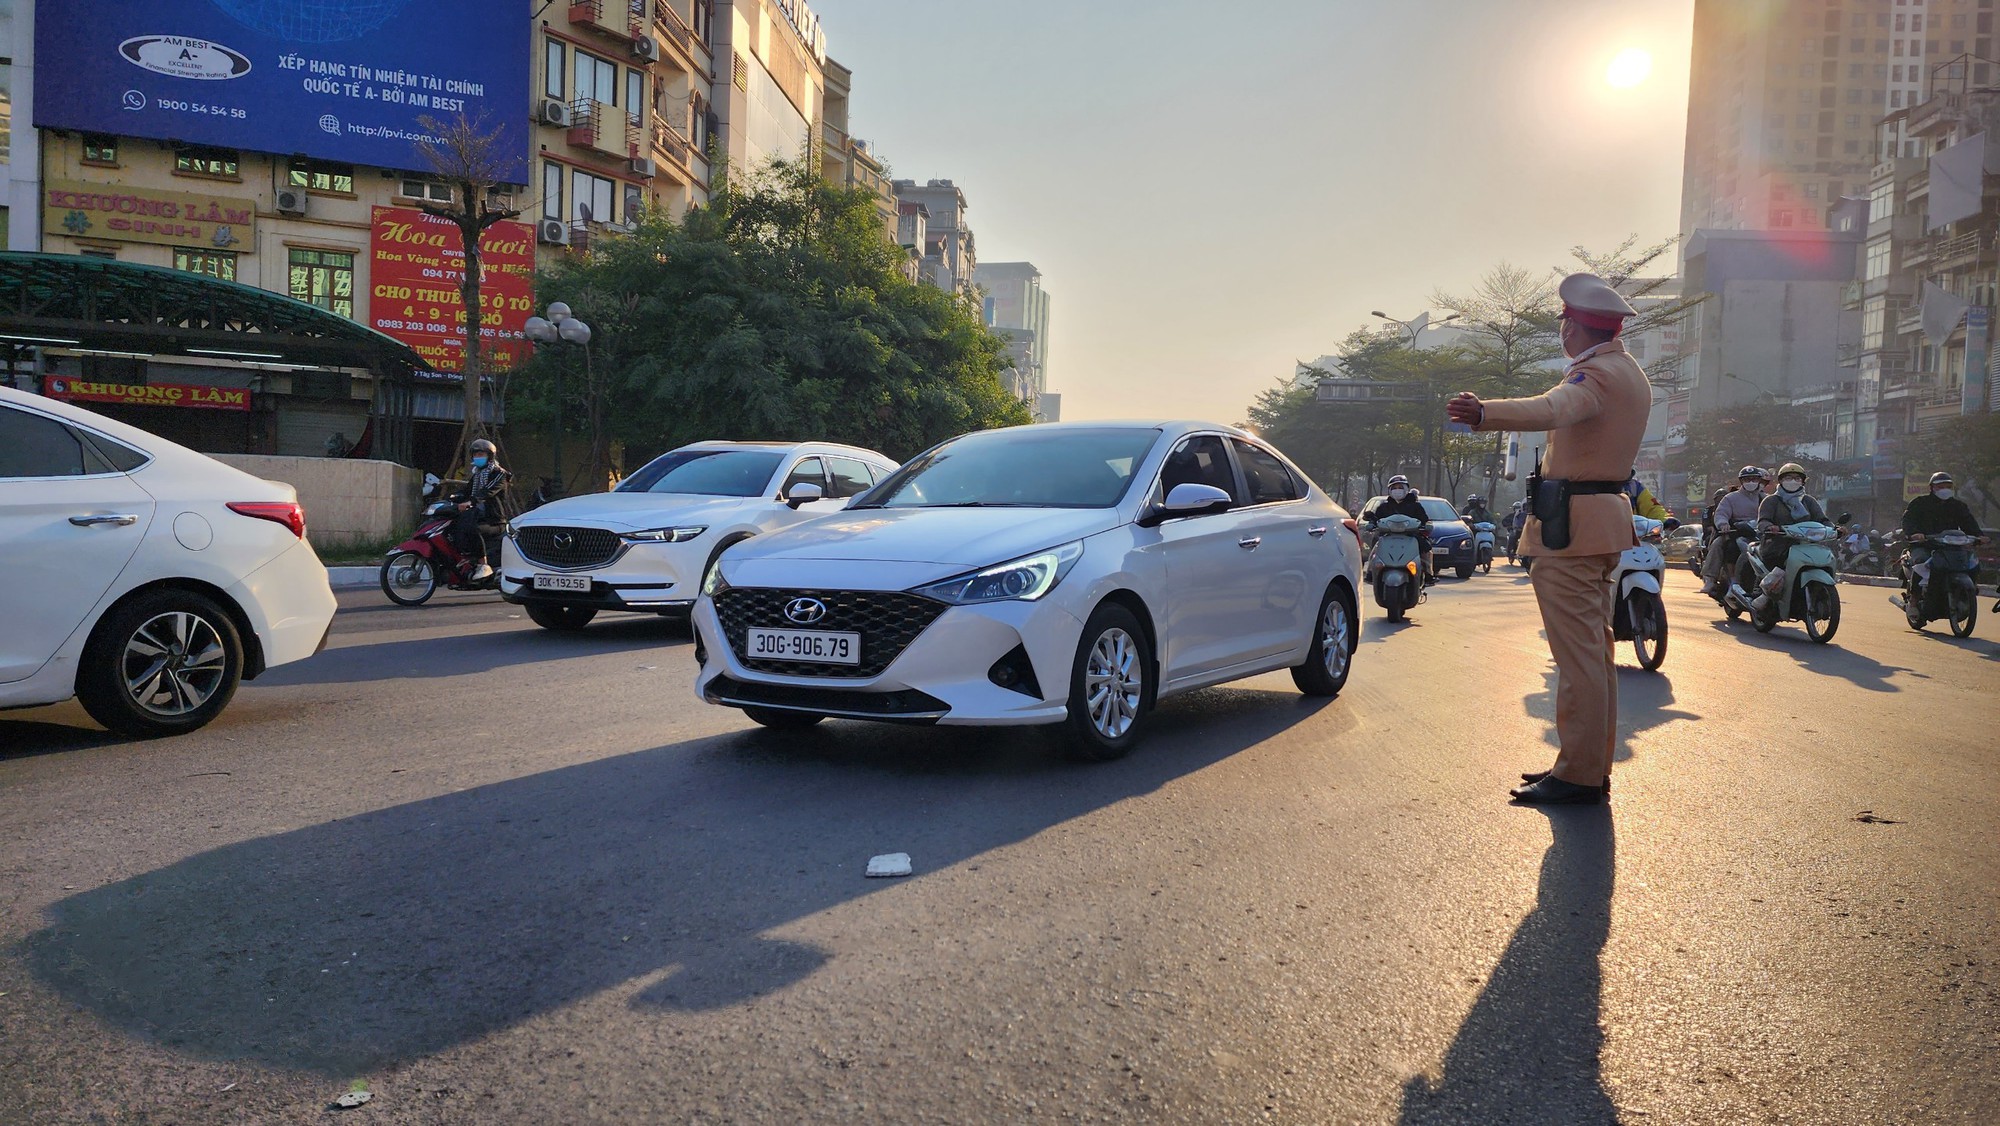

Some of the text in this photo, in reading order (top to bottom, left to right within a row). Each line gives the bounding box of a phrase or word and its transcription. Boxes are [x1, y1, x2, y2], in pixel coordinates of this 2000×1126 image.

[164, 37, 209, 49] AM BEST
[178, 48, 199, 61] A-
[145, 62, 228, 79] Financial Strength Rating
[168, 60, 203, 69] EXCELLENT
[278, 52, 484, 97] XẾP HẠNG TÍN NHIỆM TÀI CHÍNH
[303, 76, 465, 112] QUỐC TẾ A- BỞI AM BEST
[157, 98, 247, 119] 1900 54 54 58
[347, 122, 450, 145] http://pvi.com.vn
[184, 201, 251, 225] LÂM
[107, 218, 200, 238] SINH
[380, 221, 447, 247] Hoa
[376, 250, 402, 262] Hoa
[407, 253, 439, 267] Vòng
[422, 268, 443, 279] 094
[374, 285, 411, 300] CHO
[415, 287, 462, 305] THUÊ
[492, 293, 505, 309] Ô
[509, 296, 531, 311] TÔ
[403, 305, 414, 319] 4
[429, 307, 441, 320] 9
[376, 319, 403, 329] 0983
[406, 320, 424, 331] 203
[426, 322, 447, 333] 008
[479, 327, 496, 337] 765
[416, 343, 449, 356] THUỐC
[190, 387, 244, 404] LÂM
[537, 576, 585, 589] 30K-192.56
[756, 633, 849, 657] 30G-906.79
